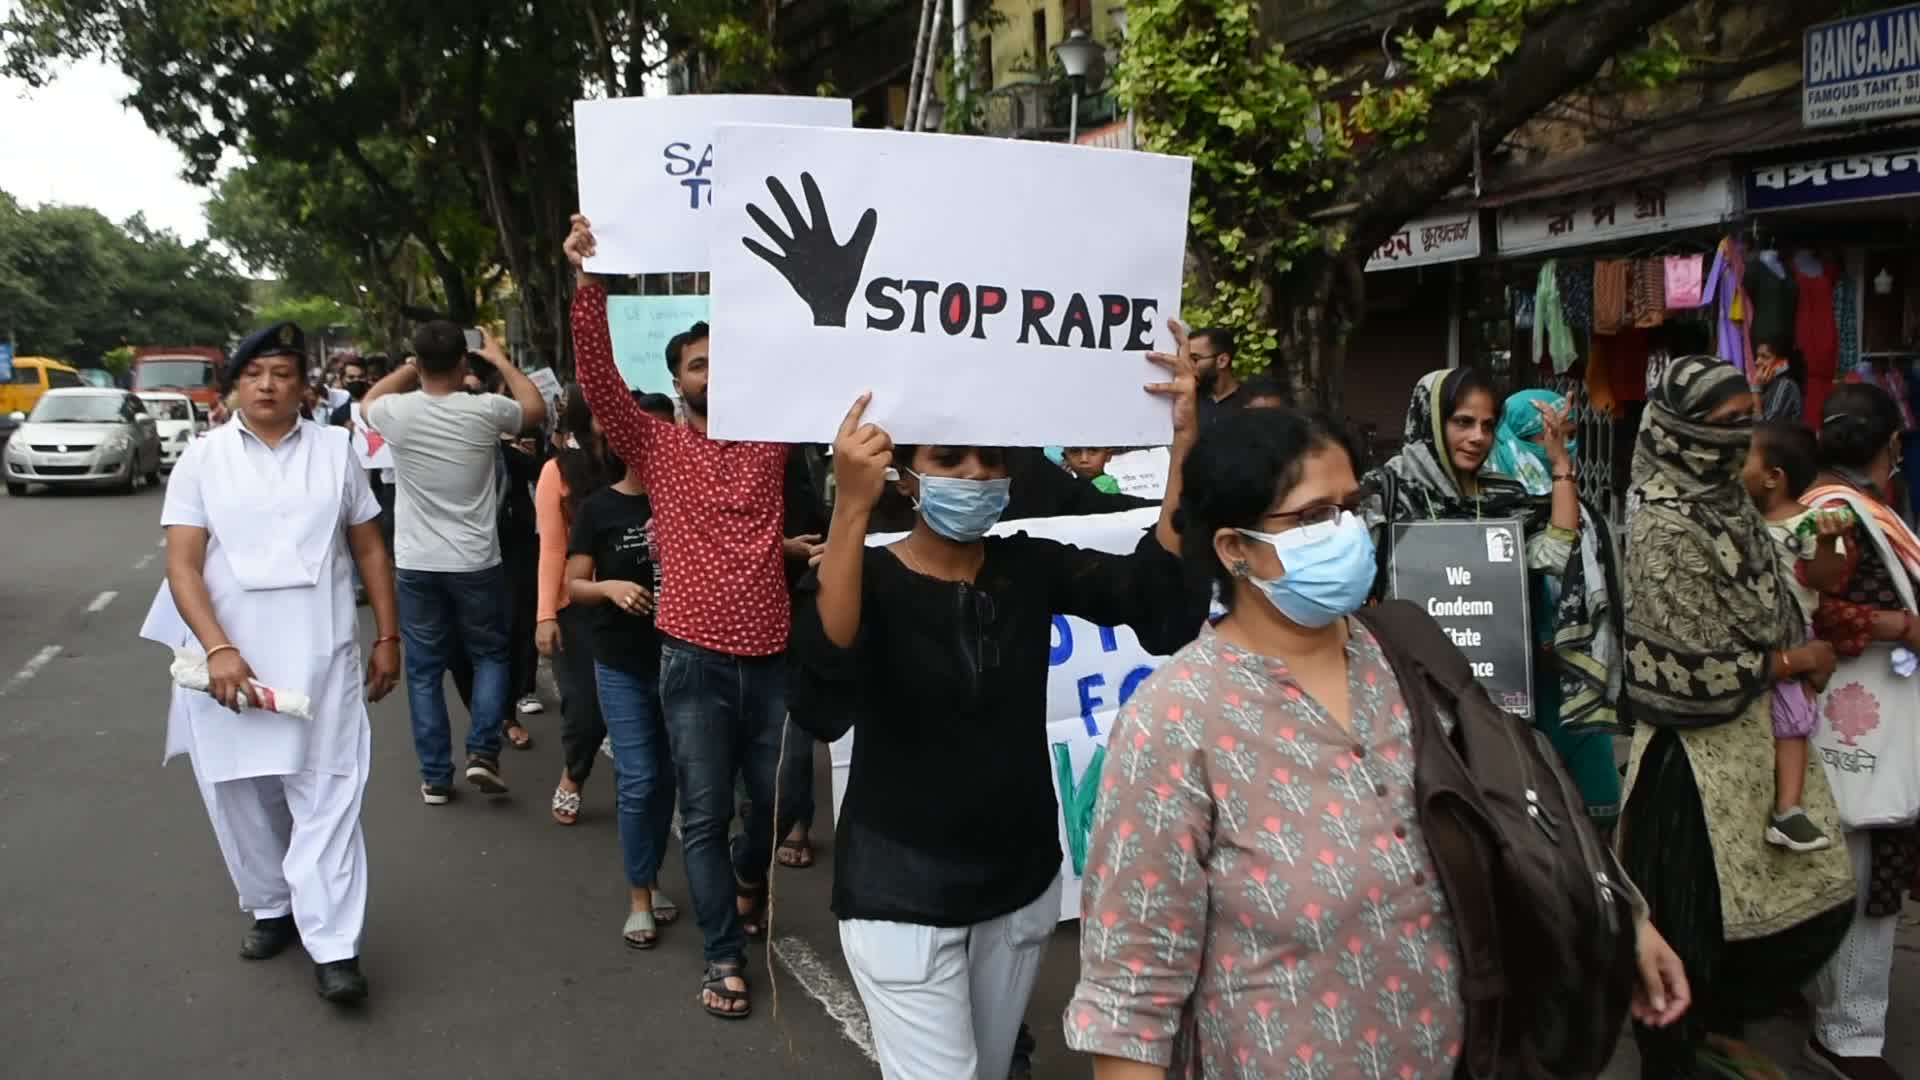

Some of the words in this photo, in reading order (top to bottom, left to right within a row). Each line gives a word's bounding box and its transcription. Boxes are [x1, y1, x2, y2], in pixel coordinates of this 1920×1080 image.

[1808, 84, 1859, 104] FAMOUS
[864, 276, 1007, 340] STOP
[1016, 288, 1158, 351] RAPE
[1446, 566, 1471, 586] We
[1428, 596, 1494, 617] Condemn
